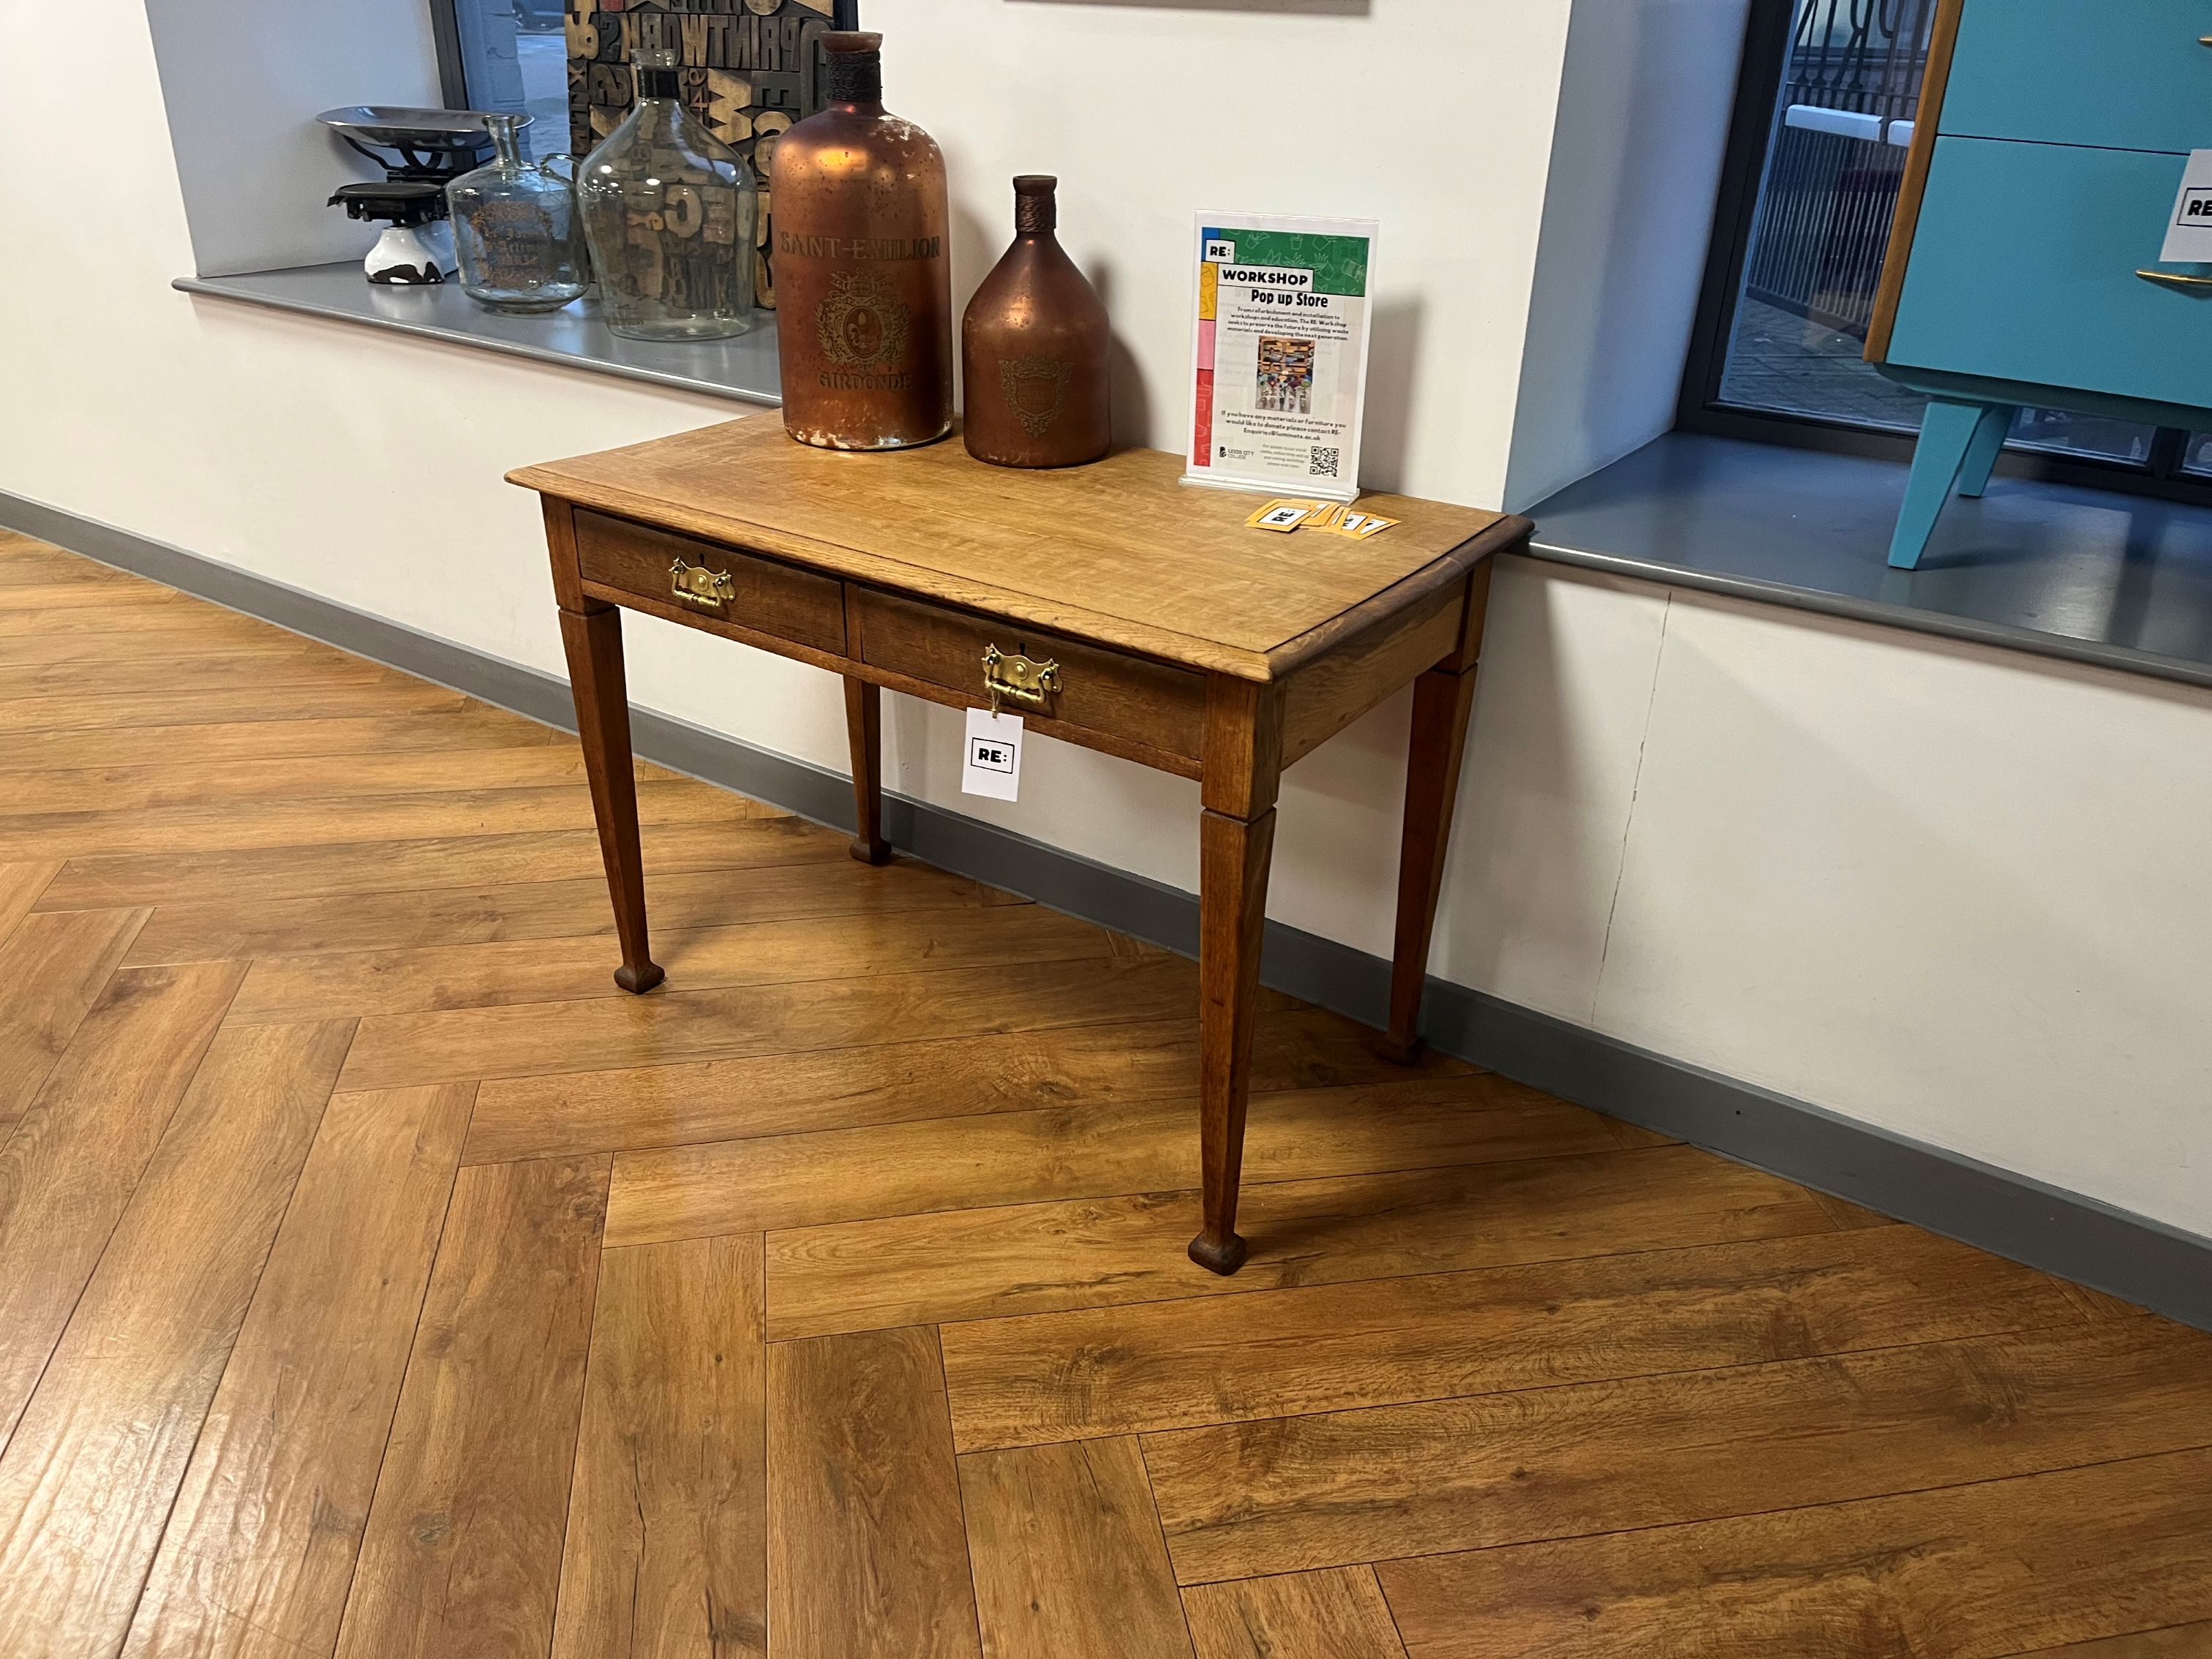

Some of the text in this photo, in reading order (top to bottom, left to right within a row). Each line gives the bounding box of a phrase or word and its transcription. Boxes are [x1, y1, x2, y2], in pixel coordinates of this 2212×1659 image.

[1210, 246, 1230, 257] RE:
[1222, 269, 1308, 285] WORKSHOP
[1252, 289, 1328, 307] Pop up Store
[1305, 418, 1333, 426] furniture
[1271, 510, 1295, 522] RE:
[978, 748, 1007, 763] RE:
